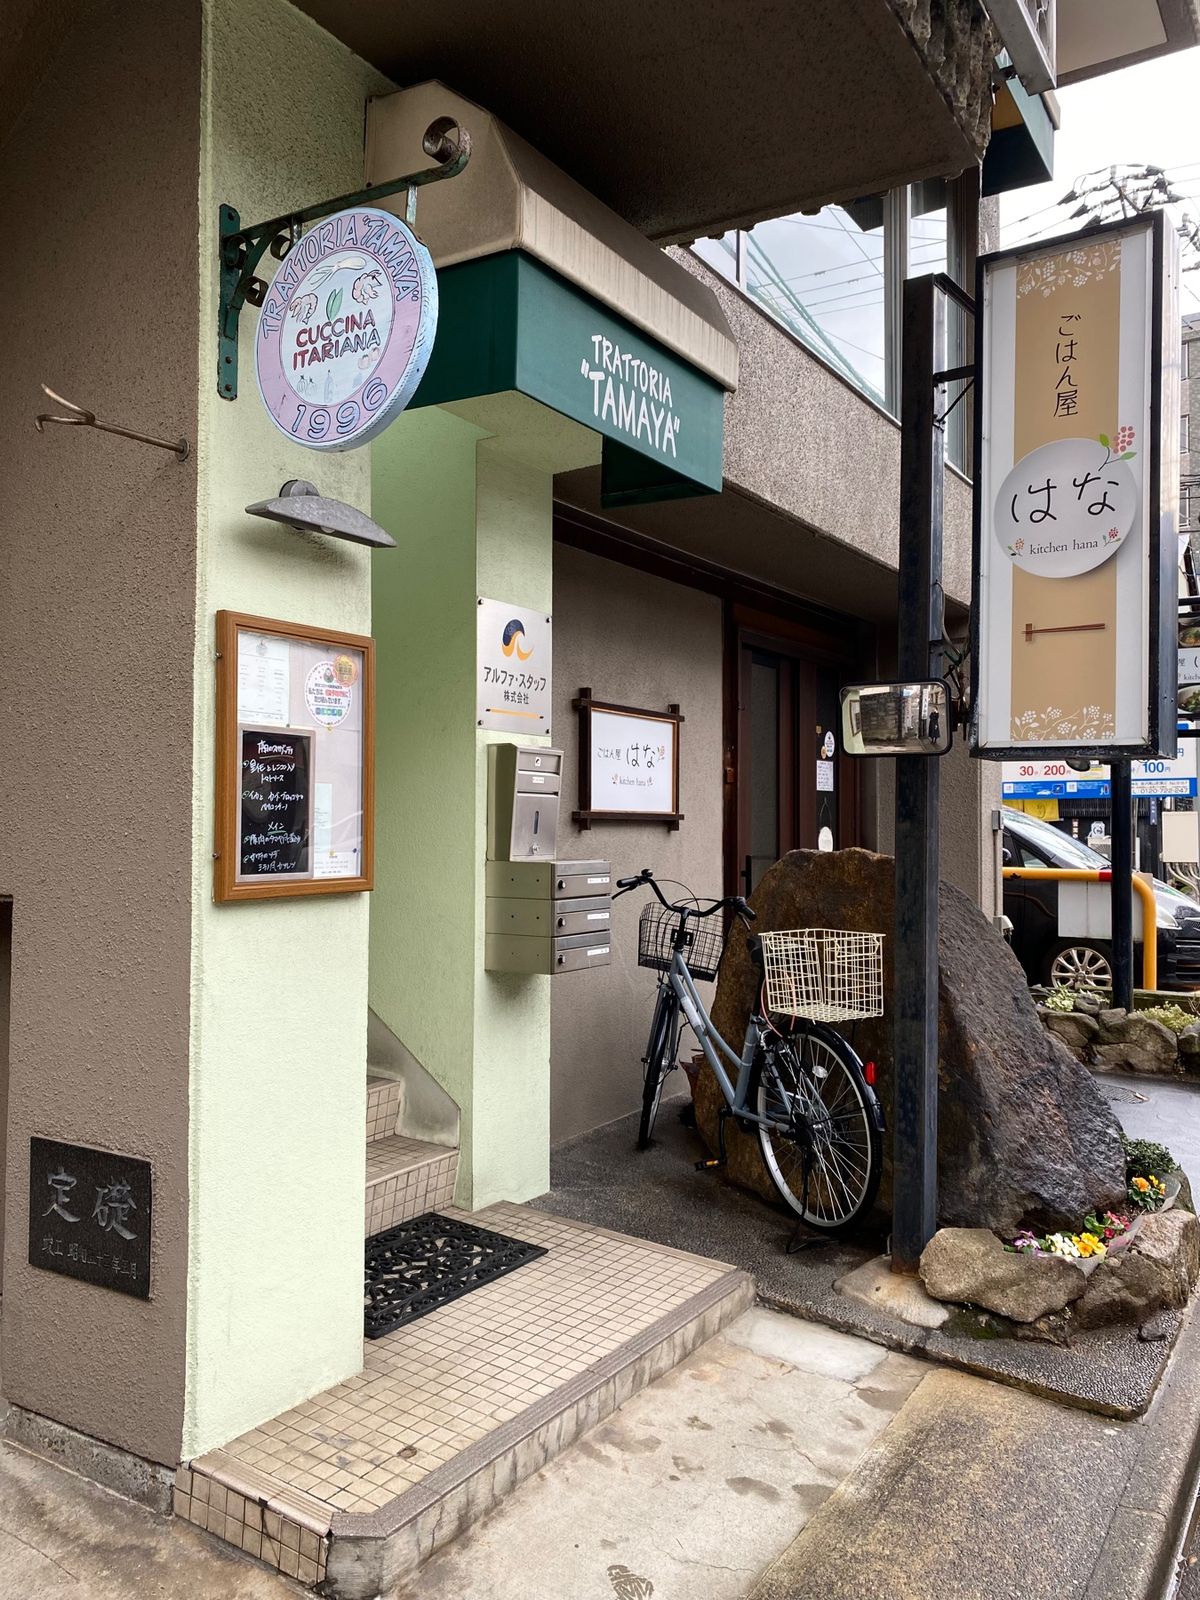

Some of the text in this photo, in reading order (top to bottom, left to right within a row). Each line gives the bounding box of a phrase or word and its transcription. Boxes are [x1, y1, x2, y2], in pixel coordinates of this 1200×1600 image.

[262, 216, 357, 339] TRATTORIA
[292, 328, 381, 371] ITARIANA
[296, 309, 375, 348] CUCCINA
[591, 334, 673, 408] TRATTORIA
[1054, 314, 1082, 418] ごはん屋
[291, 376, 388, 439] 1996
[1011, 472, 1119, 524] はな
[1029, 539, 1098, 555] kitchen hana
[483, 666, 547, 692] アルファ・スタッフ
[503, 690, 529, 704] 株式会社
[598, 743, 656, 768] ごはん屋 はな
[620, 776, 635, 784] kitchen
[42, 1167, 138, 1240] 定礎
